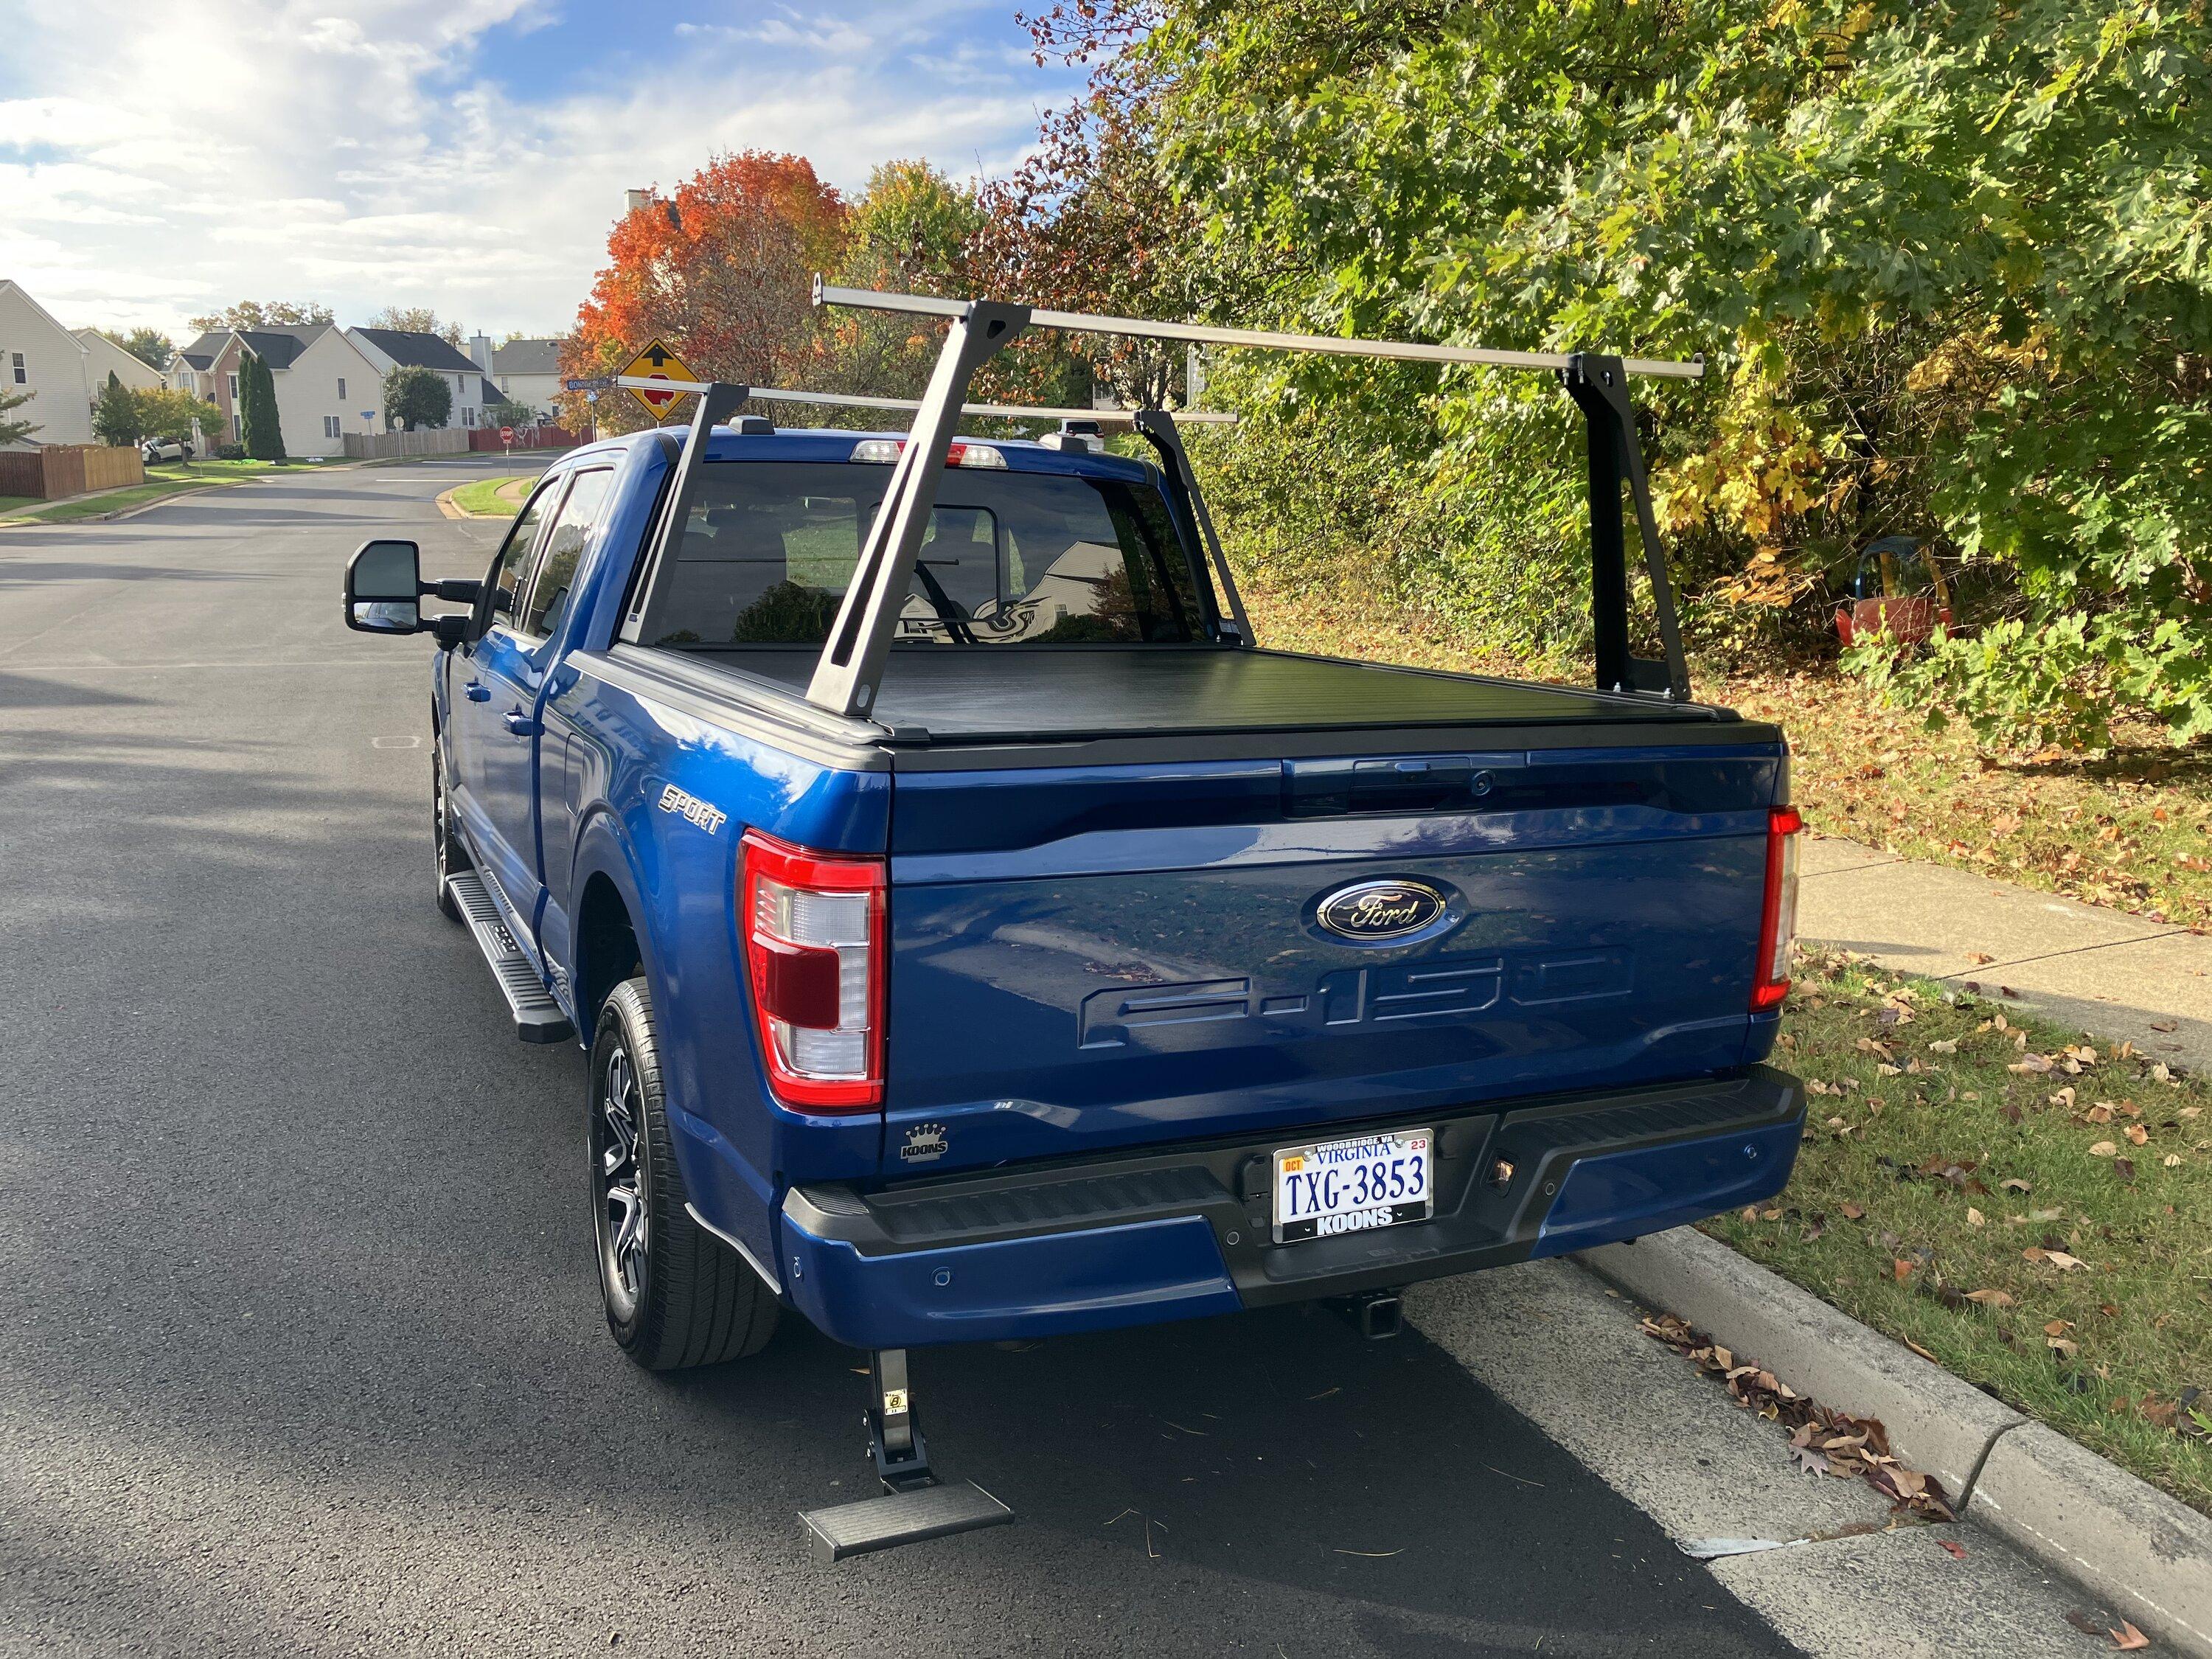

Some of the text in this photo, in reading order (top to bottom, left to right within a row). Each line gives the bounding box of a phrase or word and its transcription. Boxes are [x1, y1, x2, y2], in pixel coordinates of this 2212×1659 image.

[658, 783, 727, 835] SPORT
[1338, 893, 1419, 928] Ford
[1076, 945, 1634, 1050] F-150
[902, 1142, 947, 1158] KOONS
[1381, 1135, 1393, 1144] VA
[1411, 1139, 1426, 1150] 23
[1286, 1160, 1301, 1172] OCT
[1317, 1143, 1391, 1165] VIRGINIA
[1286, 1155, 1424, 1216] TXG-3853
[1317, 1206, 1393, 1236] KOONS
